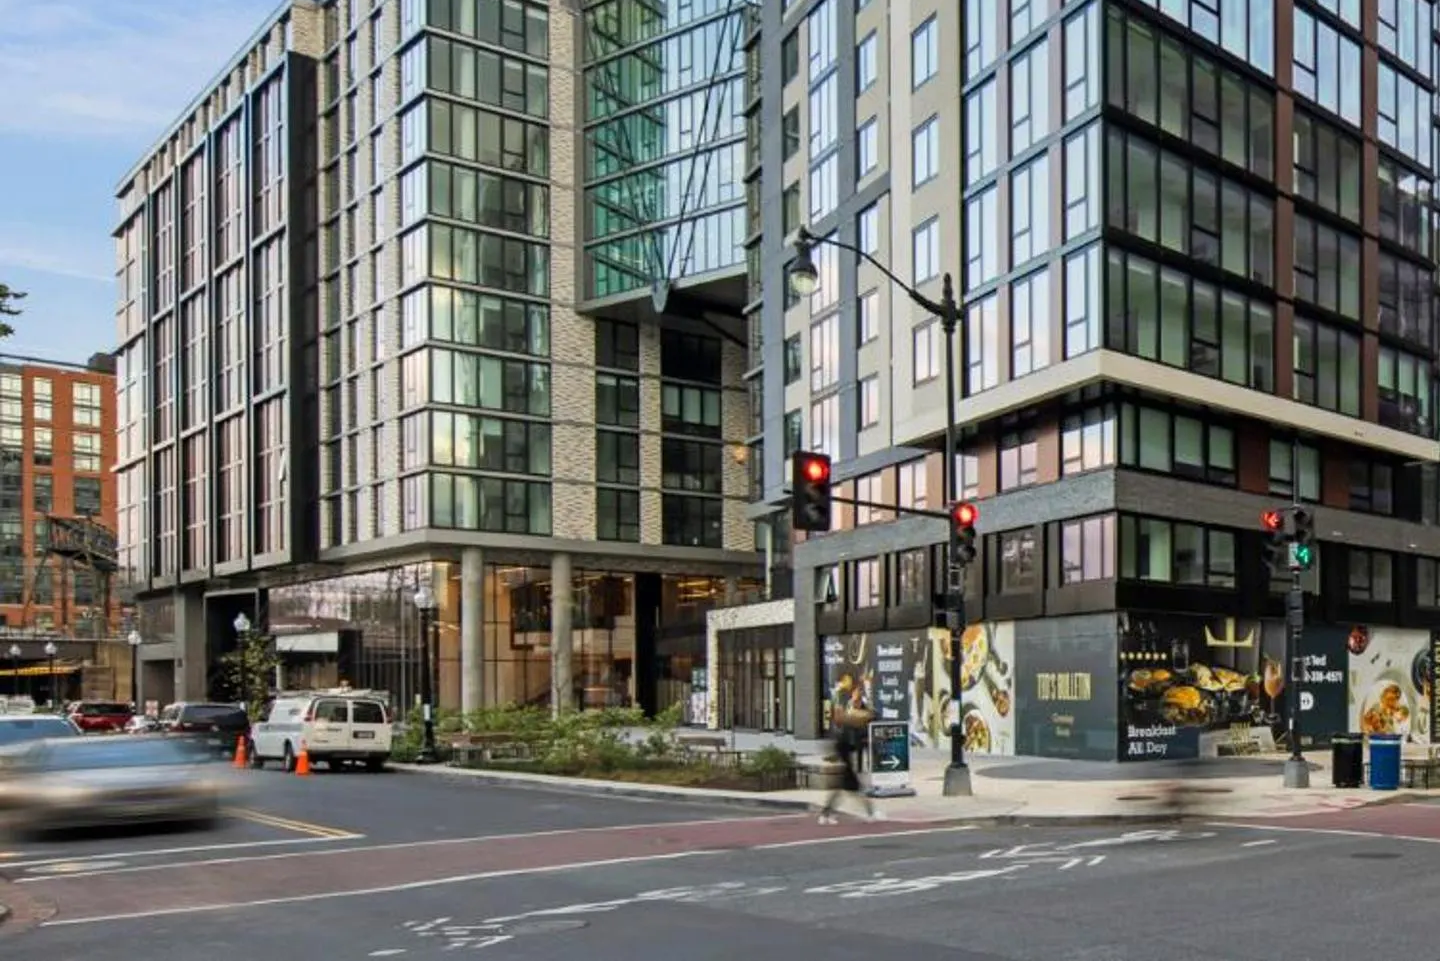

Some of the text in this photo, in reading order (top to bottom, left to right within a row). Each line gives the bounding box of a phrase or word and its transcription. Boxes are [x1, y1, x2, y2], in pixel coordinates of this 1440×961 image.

[1036, 672, 1091, 701] TED'S BULLETIN
[1127, 724, 1176, 738] Breakfast
[1127, 741, 1168, 755] All Day
